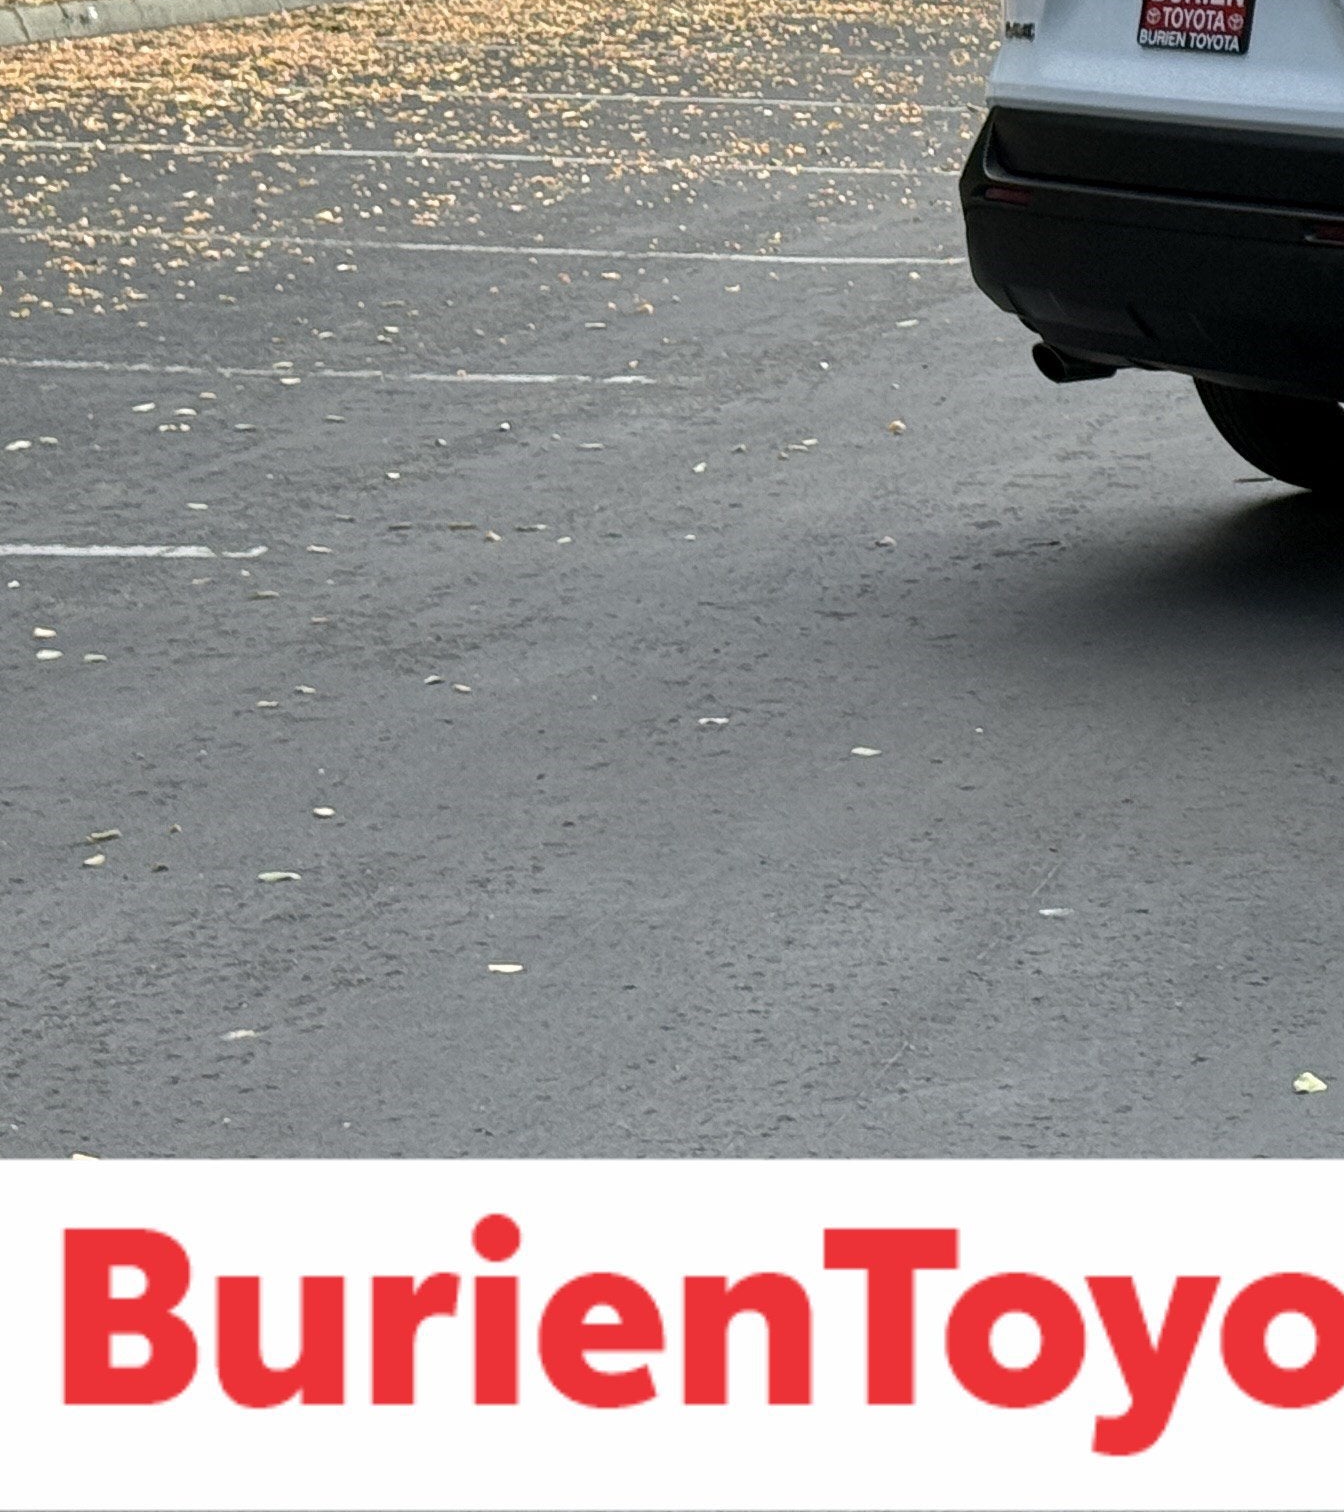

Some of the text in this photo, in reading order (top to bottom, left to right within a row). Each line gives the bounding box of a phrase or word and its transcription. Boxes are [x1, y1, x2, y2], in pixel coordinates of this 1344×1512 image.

[1163, 7, 1226, 31] TOYOTA
[1139, 28, 1239, 51] BURIEN TOYOTA
